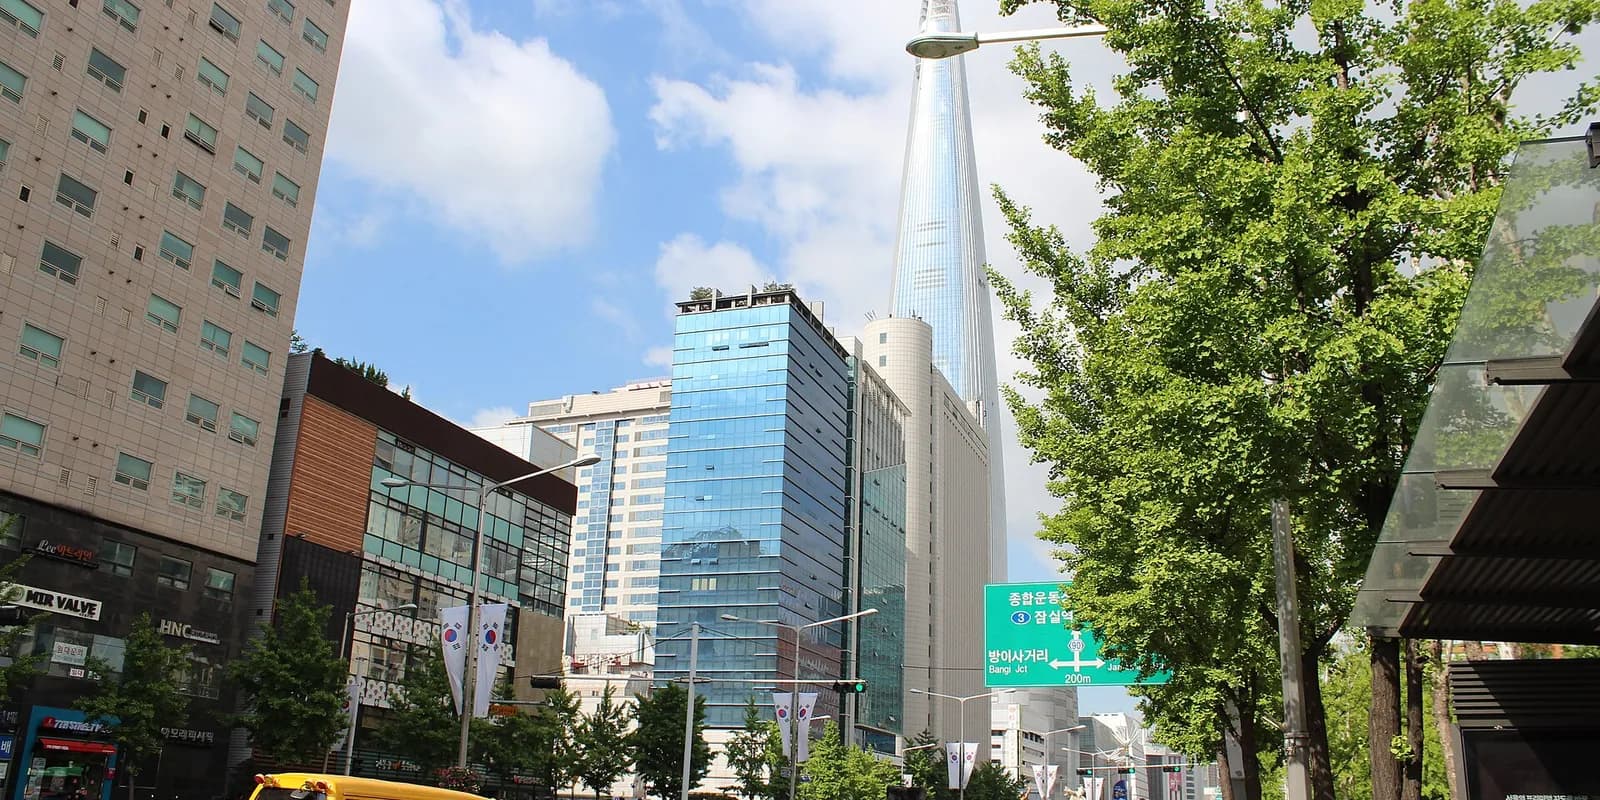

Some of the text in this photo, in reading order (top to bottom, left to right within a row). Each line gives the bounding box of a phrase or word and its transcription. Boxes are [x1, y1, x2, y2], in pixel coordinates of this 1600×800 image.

[25, 590, 98, 615] MIR VALVE
[1017, 613, 1025, 623] 3
[1034, 610, 1074, 624] 잠실역
[160, 619, 192, 638] HNC
[1071, 641, 1082, 650] 90
[988, 649, 1049, 663] 방이사거리
[988, 665, 1028, 676] Bangi Jct
[1064, 674, 1092, 684] 200m
